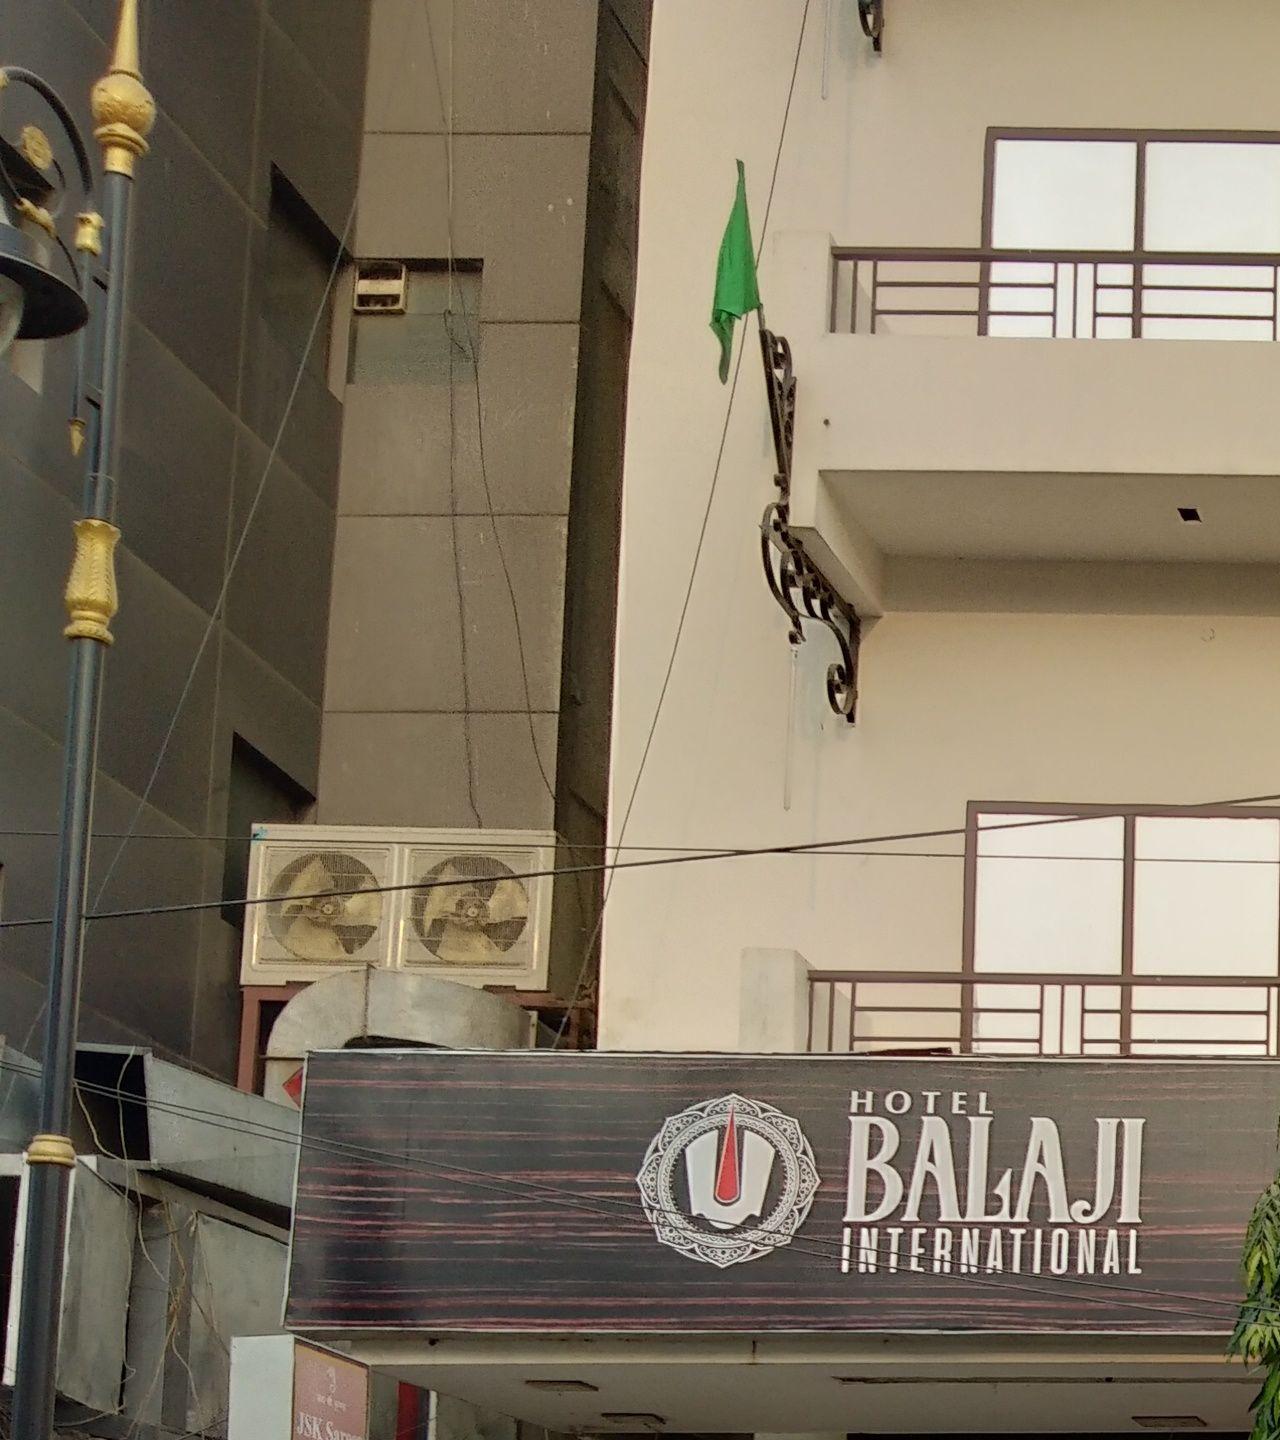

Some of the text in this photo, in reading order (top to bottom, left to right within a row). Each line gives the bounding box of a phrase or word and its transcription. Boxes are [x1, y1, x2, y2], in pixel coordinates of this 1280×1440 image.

[850, 1090, 993, 1114] HOTEL
[842, 1116, 1146, 1223] BALAJI
[841, 1228, 1142, 1275] INTERNATIONAL
[297, 1411, 323, 1440] JSK
